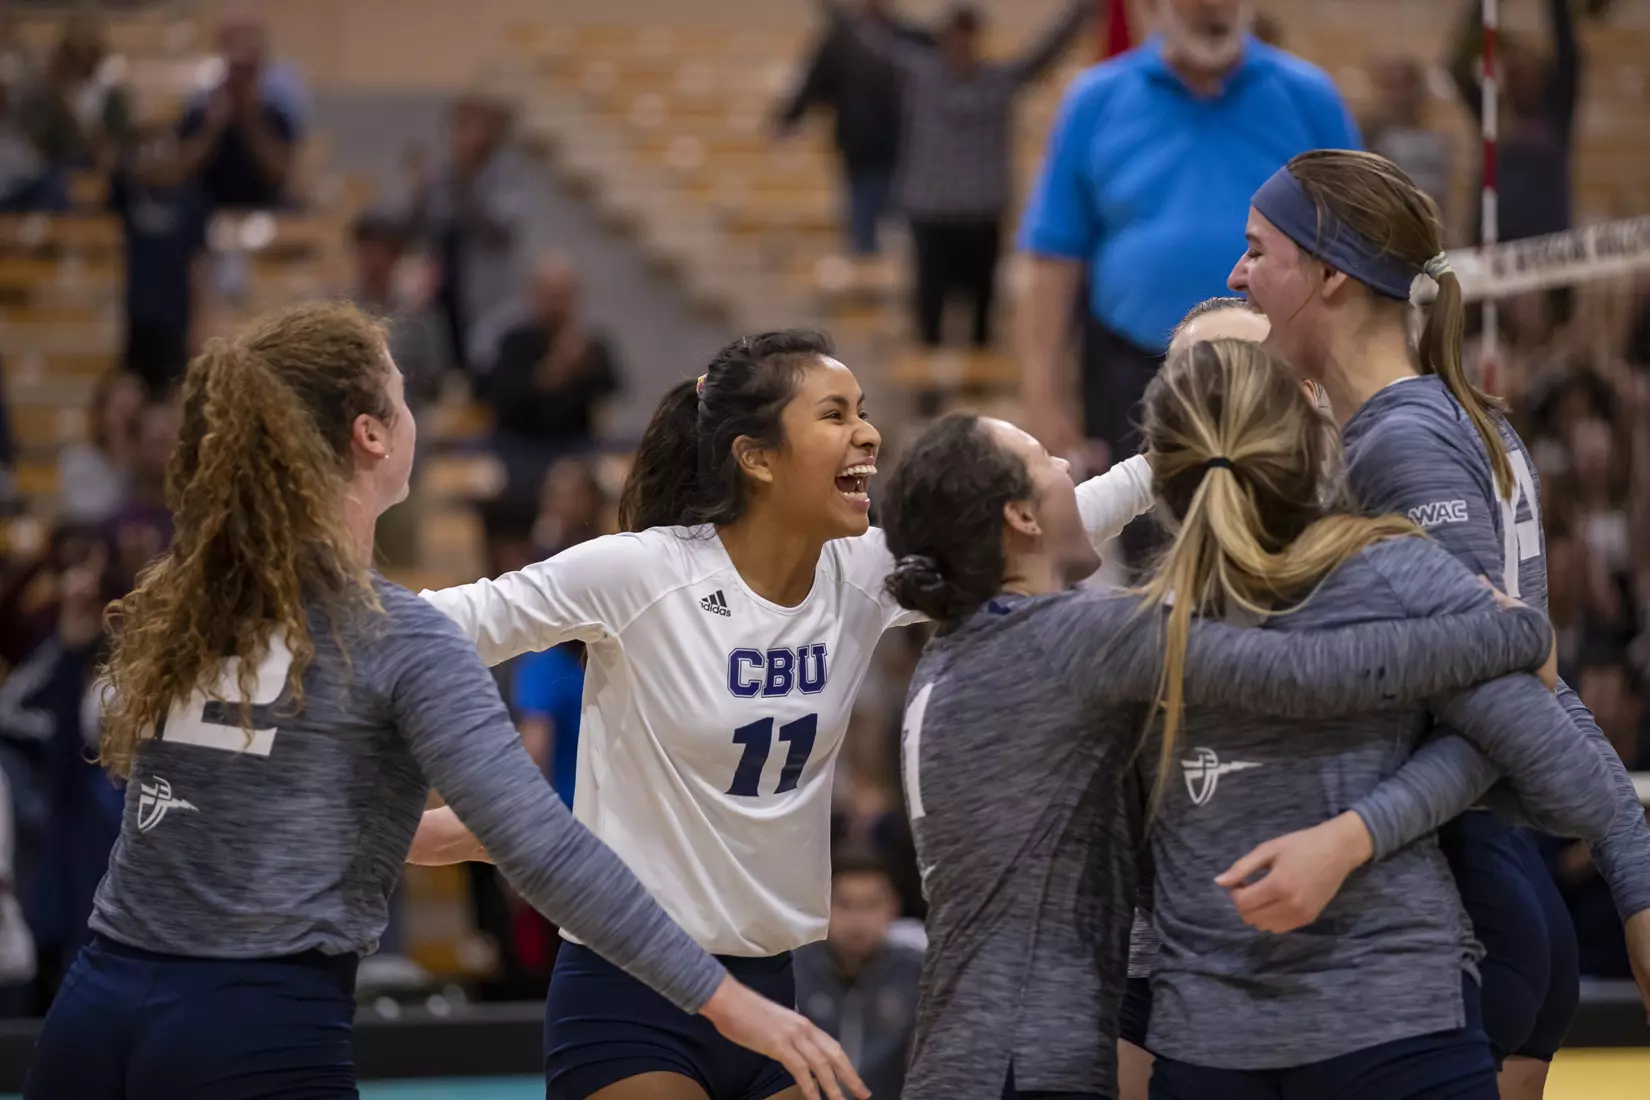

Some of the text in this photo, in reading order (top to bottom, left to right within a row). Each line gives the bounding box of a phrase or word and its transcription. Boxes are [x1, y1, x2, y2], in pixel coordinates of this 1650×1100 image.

[1408, 500, 1468, 526] WAC
[727, 643, 828, 698] CBU
[725, 713, 818, 797] 11
